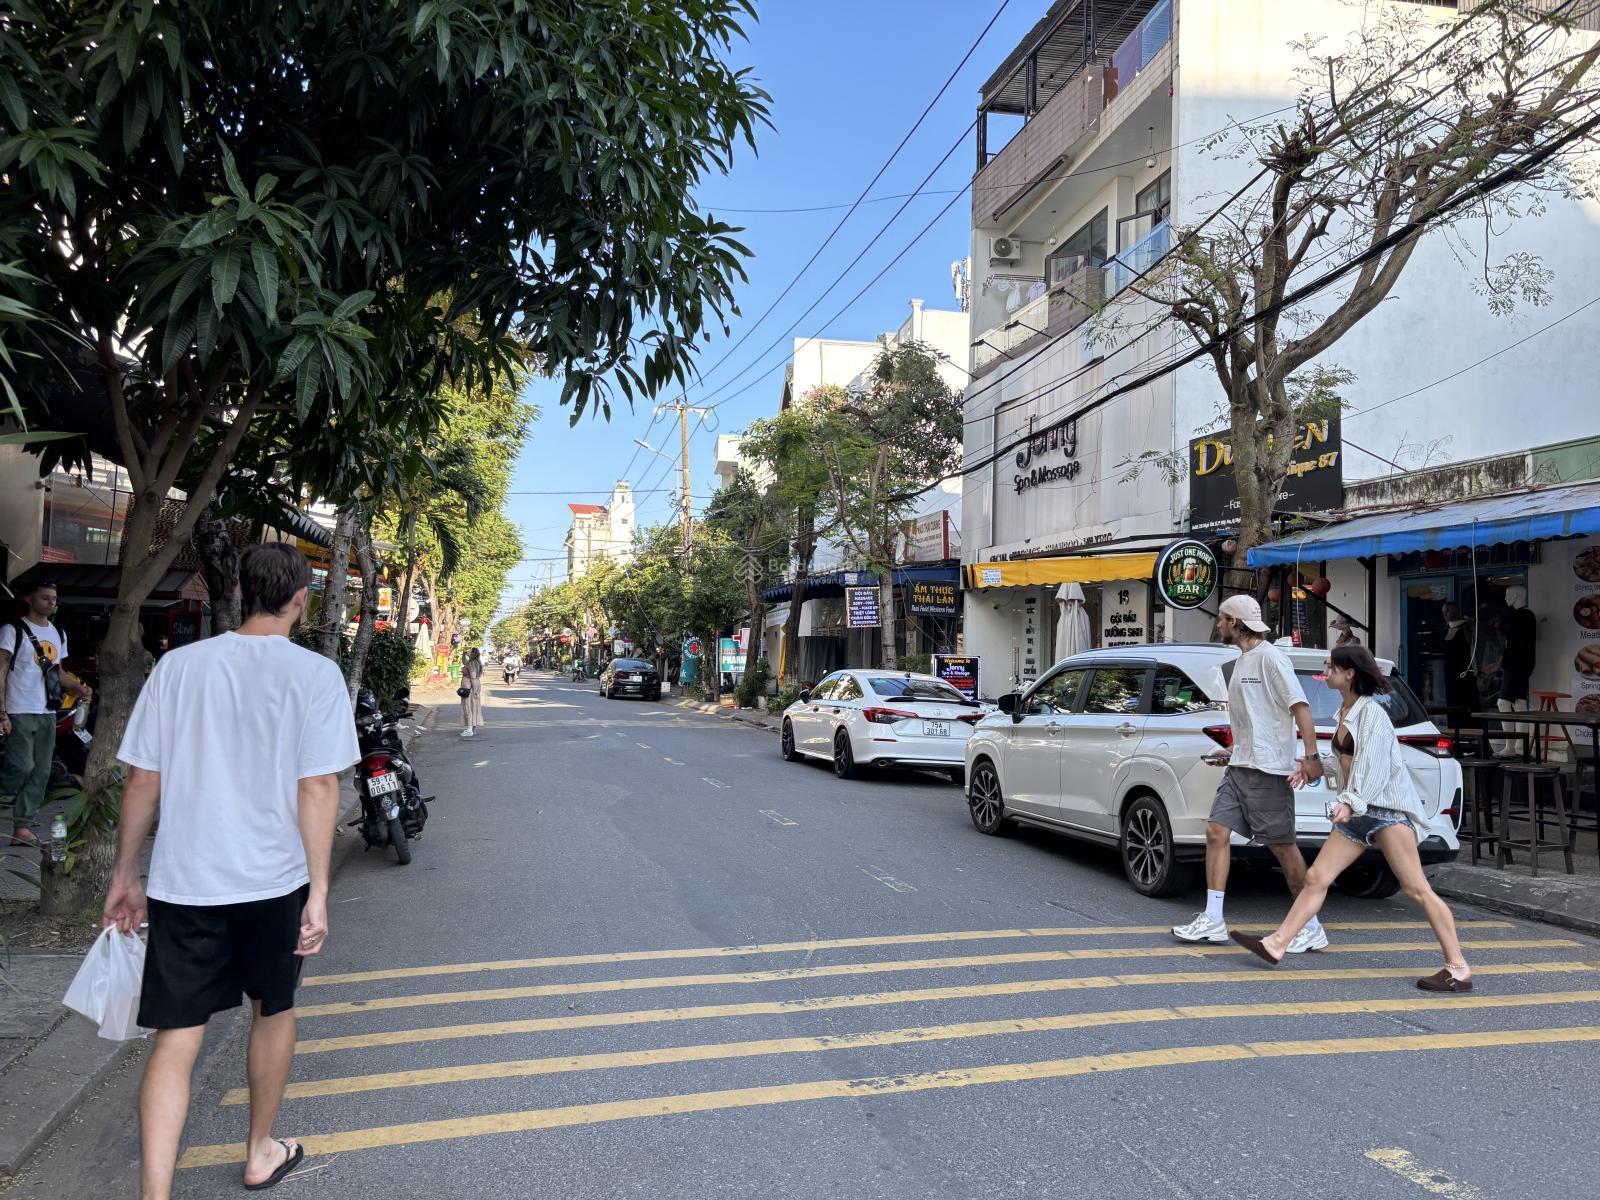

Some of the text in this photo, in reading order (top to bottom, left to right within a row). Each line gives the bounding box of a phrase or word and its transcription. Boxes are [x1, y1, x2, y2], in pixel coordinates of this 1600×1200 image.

[1318, 451, 1339, 468] 87
[1170, 548, 1214, 565] JUST ONE MORE
[1177, 584, 1200, 595] BAR
[722, 655, 747, 664] PHARM
[931, 721, 943, 729] 75A
